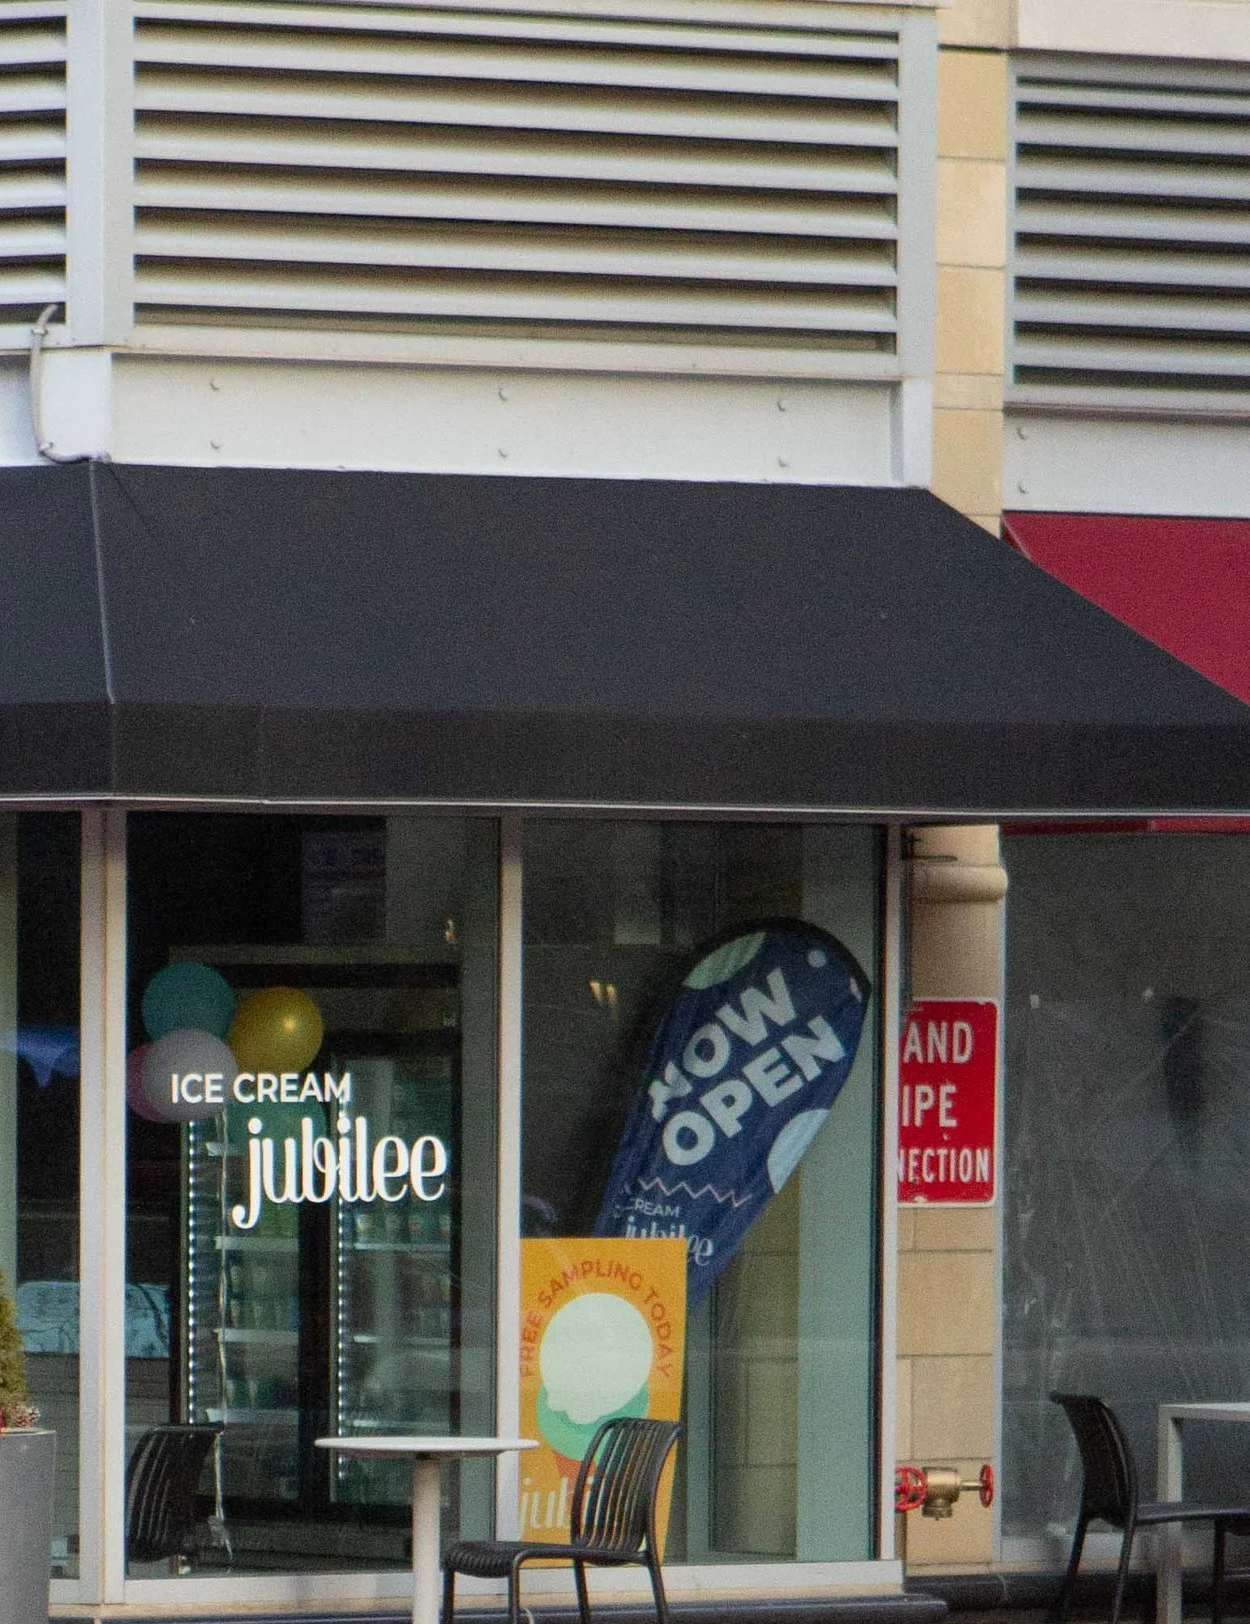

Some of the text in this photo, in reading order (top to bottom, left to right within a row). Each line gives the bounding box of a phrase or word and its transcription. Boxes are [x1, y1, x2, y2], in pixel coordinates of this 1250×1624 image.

[171, 1072, 352, 1104] ICE CREAM
[662, 1016, 846, 1166] OPEN
[230, 1116, 448, 1229] jubilee
[520, 1260, 675, 1379] FREE SAMPLING TODAY
